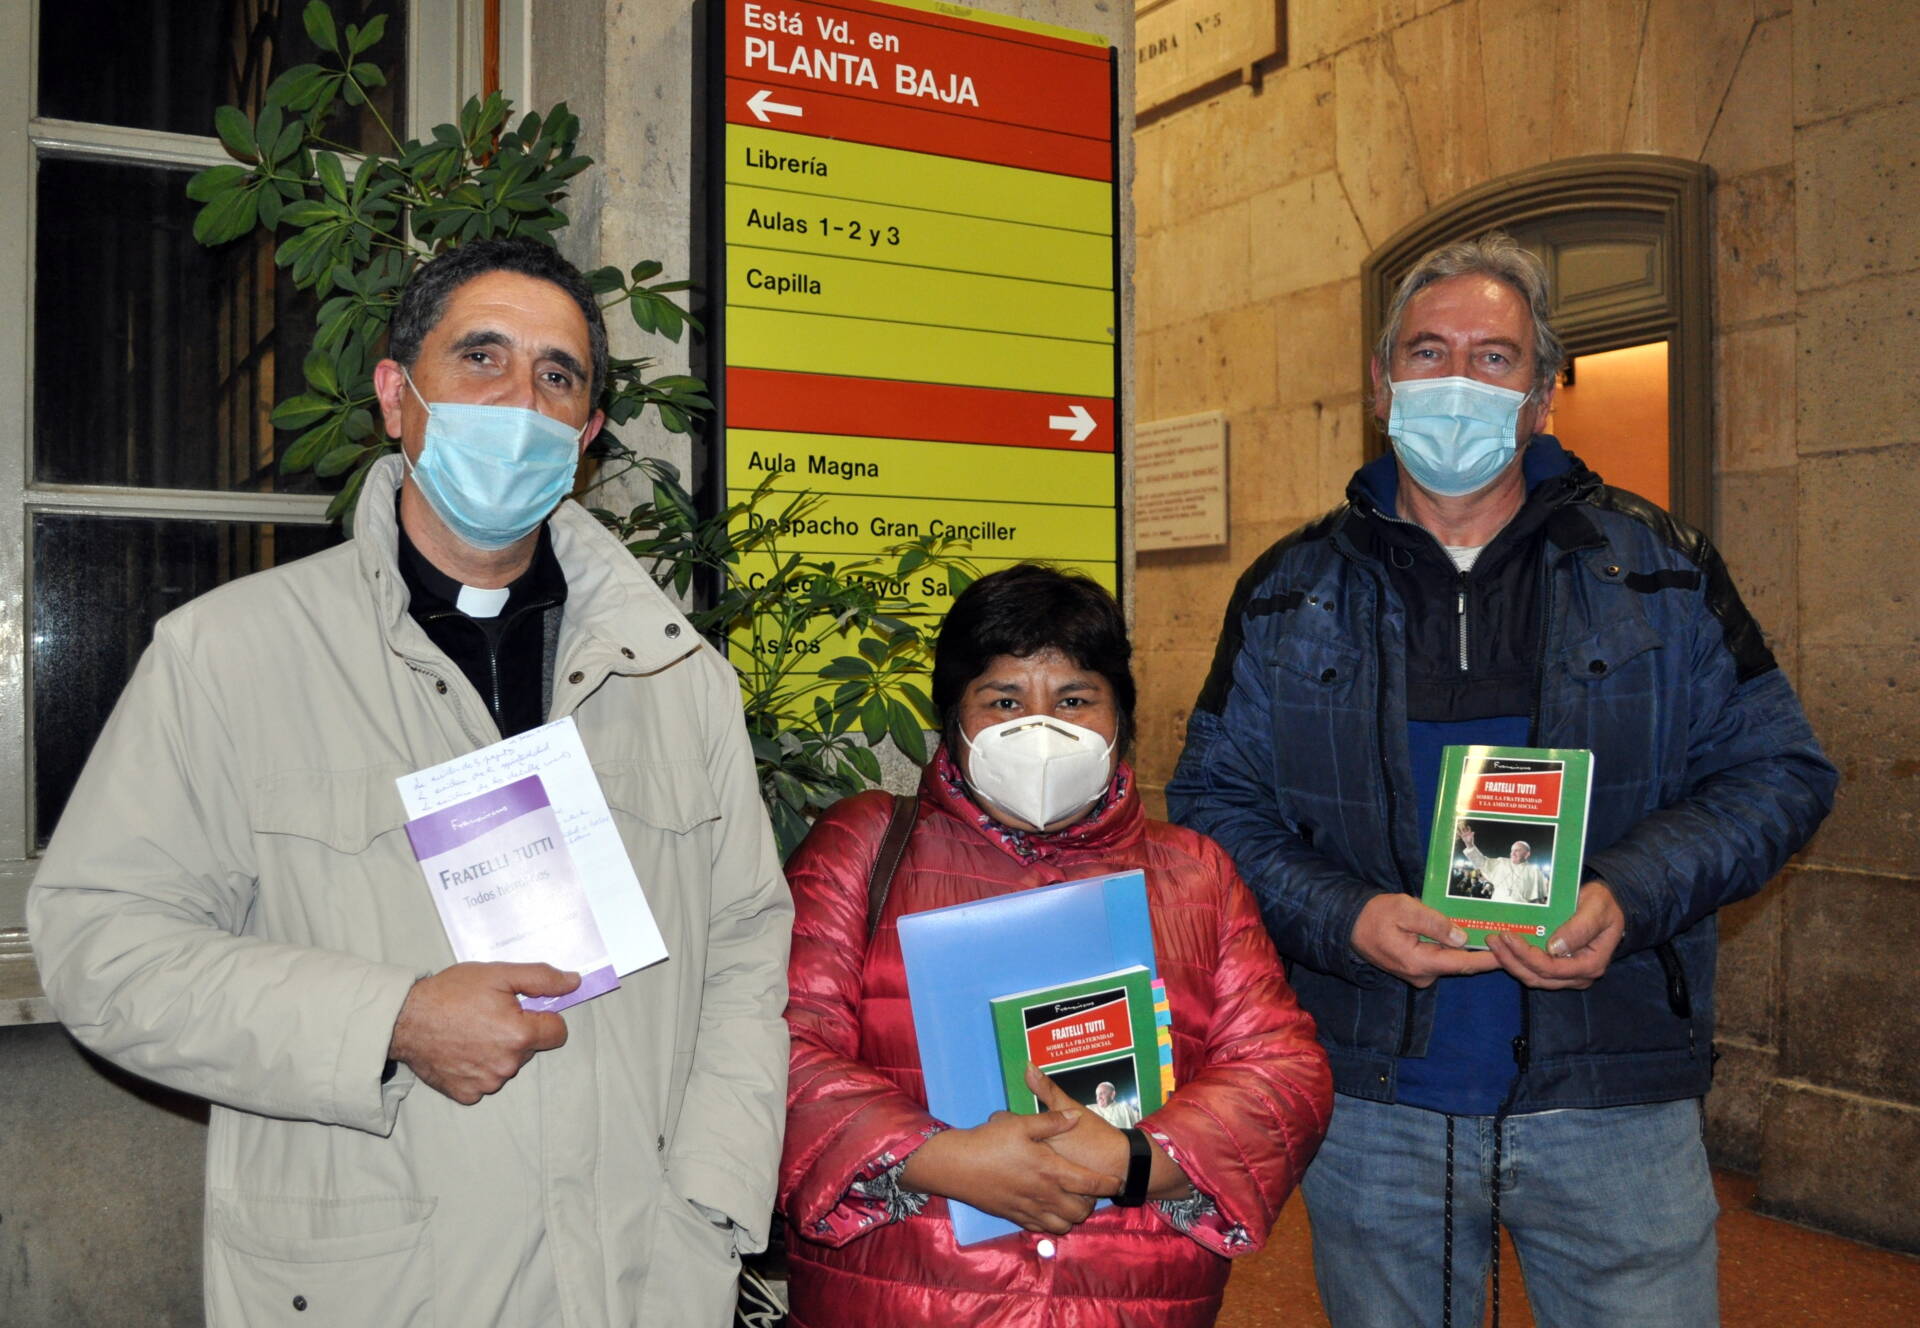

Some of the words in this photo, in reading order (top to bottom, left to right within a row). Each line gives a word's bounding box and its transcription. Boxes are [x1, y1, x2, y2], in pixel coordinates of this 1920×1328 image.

[744, 3, 803, 36] Está
[816, 16, 855, 46] Vd.
[868, 31, 900, 53] en
[744, 36, 879, 89] PLANTA
[895, 64, 980, 107] BAJA
[746, 147, 828, 177] Librería
[746, 208, 808, 235] Aulas
[869, 228, 881, 247] y
[887, 226, 900, 246] 3
[746, 268, 821, 295] Capilla
[748, 451, 796, 474] Aula
[808, 455, 879, 480] Magna
[749, 511, 859, 538] Despacho
[870, 516, 919, 538] Gran
[929, 519, 1017, 541] Canciller
[921, 577, 953, 598] Sa
[752, 635, 821, 655] Aseos
[1484, 781, 1516, 794] FRATELLI
[1516, 783, 1537, 796] TUTTI
[438, 852, 510, 891] FRATELLI
[512, 836, 555, 862] TUTTI
[462, 889, 497, 910] Todos
[1046, 1042, 1065, 1052] SOBRE
[1074, 1032, 1115, 1046] FRATERNIDAD
[1051, 1023, 1084, 1041] FRATELLI
[1084, 1019, 1106, 1034] TUTTI
[1065, 1044, 1091, 1055] AMISTAD
